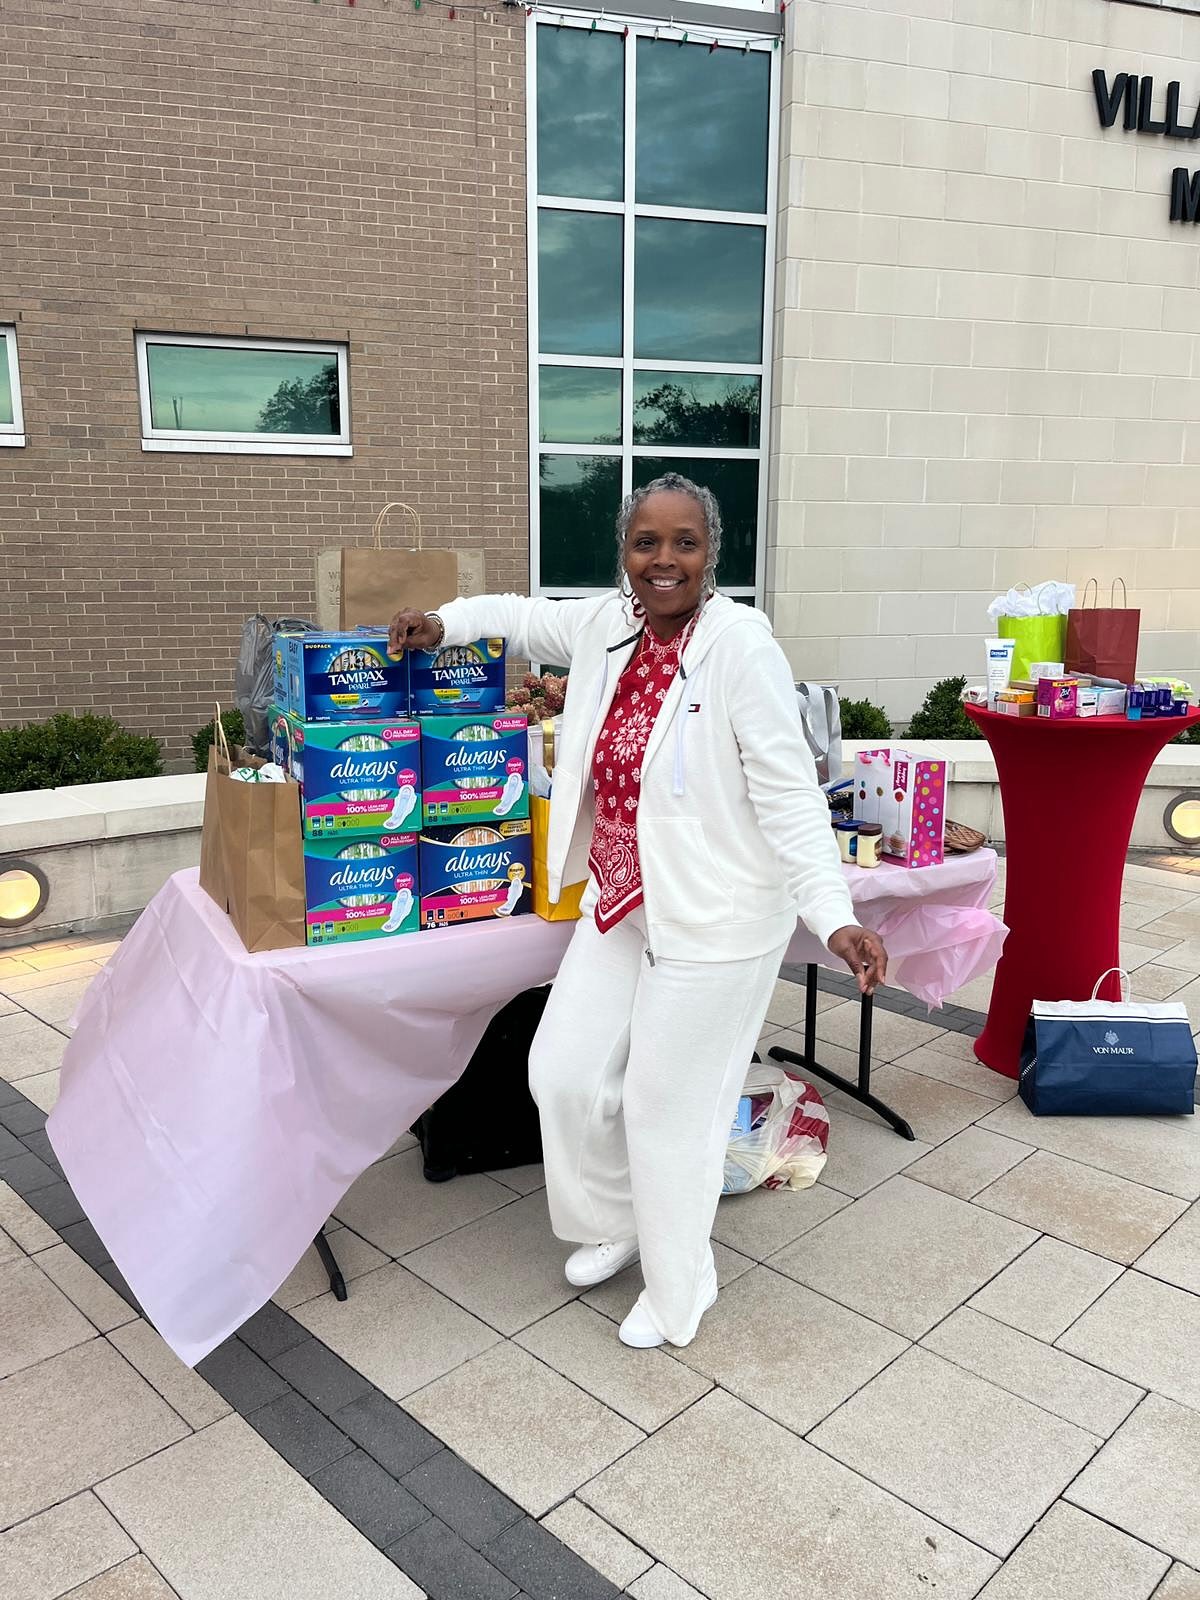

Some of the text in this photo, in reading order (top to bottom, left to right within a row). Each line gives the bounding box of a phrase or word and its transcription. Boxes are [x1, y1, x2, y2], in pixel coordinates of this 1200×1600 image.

[1092, 69, 1200, 139] VILL
[328, 670, 384, 685] TAMPAX
[432, 666, 485, 680] TAMPAX
[330, 757, 398, 782] always
[445, 746, 507, 770] always
[445, 849, 512, 874] always
[329, 865, 395, 887] always
